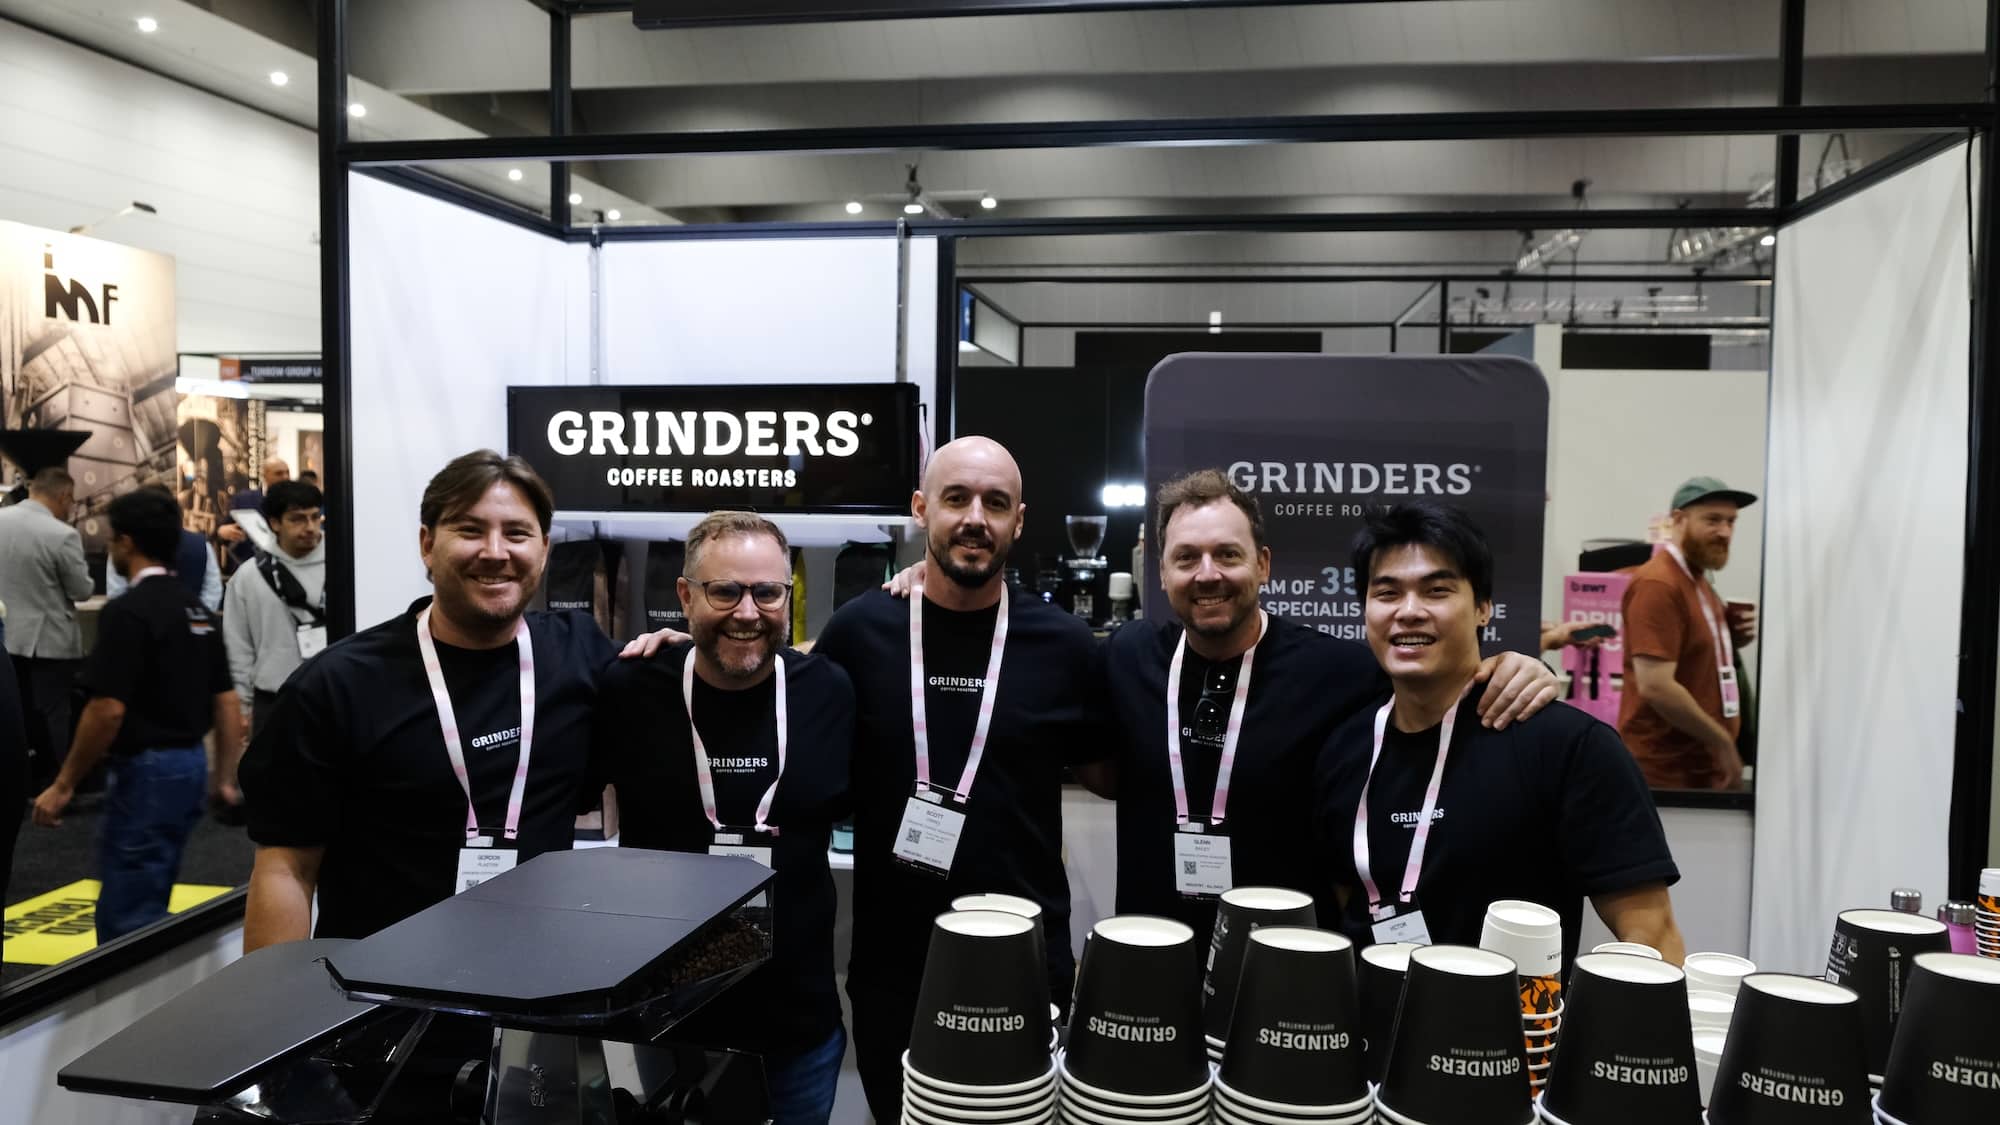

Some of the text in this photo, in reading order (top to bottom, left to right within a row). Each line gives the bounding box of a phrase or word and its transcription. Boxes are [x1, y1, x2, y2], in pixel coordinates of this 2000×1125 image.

[607, 467, 797, 488] COFFEE ROASTERS
[1274, 503, 1333, 517] COFFEE
[1291, 579, 1315, 596] OF
[648, 610, 684, 618] GRINDER
[1266, 601, 1361, 617] SPECIALIS
[1390, 808, 1445, 823] GRINRS
[936, 1011, 1025, 1033] GRINDERS
[1087, 1016, 1177, 1042] GRINDERS
[1259, 1028, 1350, 1050] GRINDERS
[1430, 1055, 1520, 1077] GRINDERS
[1594, 1061, 1688, 1085] GRINDERS
[1932, 1061, 2000, 1089] NDERS
[1741, 1072, 1844, 1106] GRINDERS
